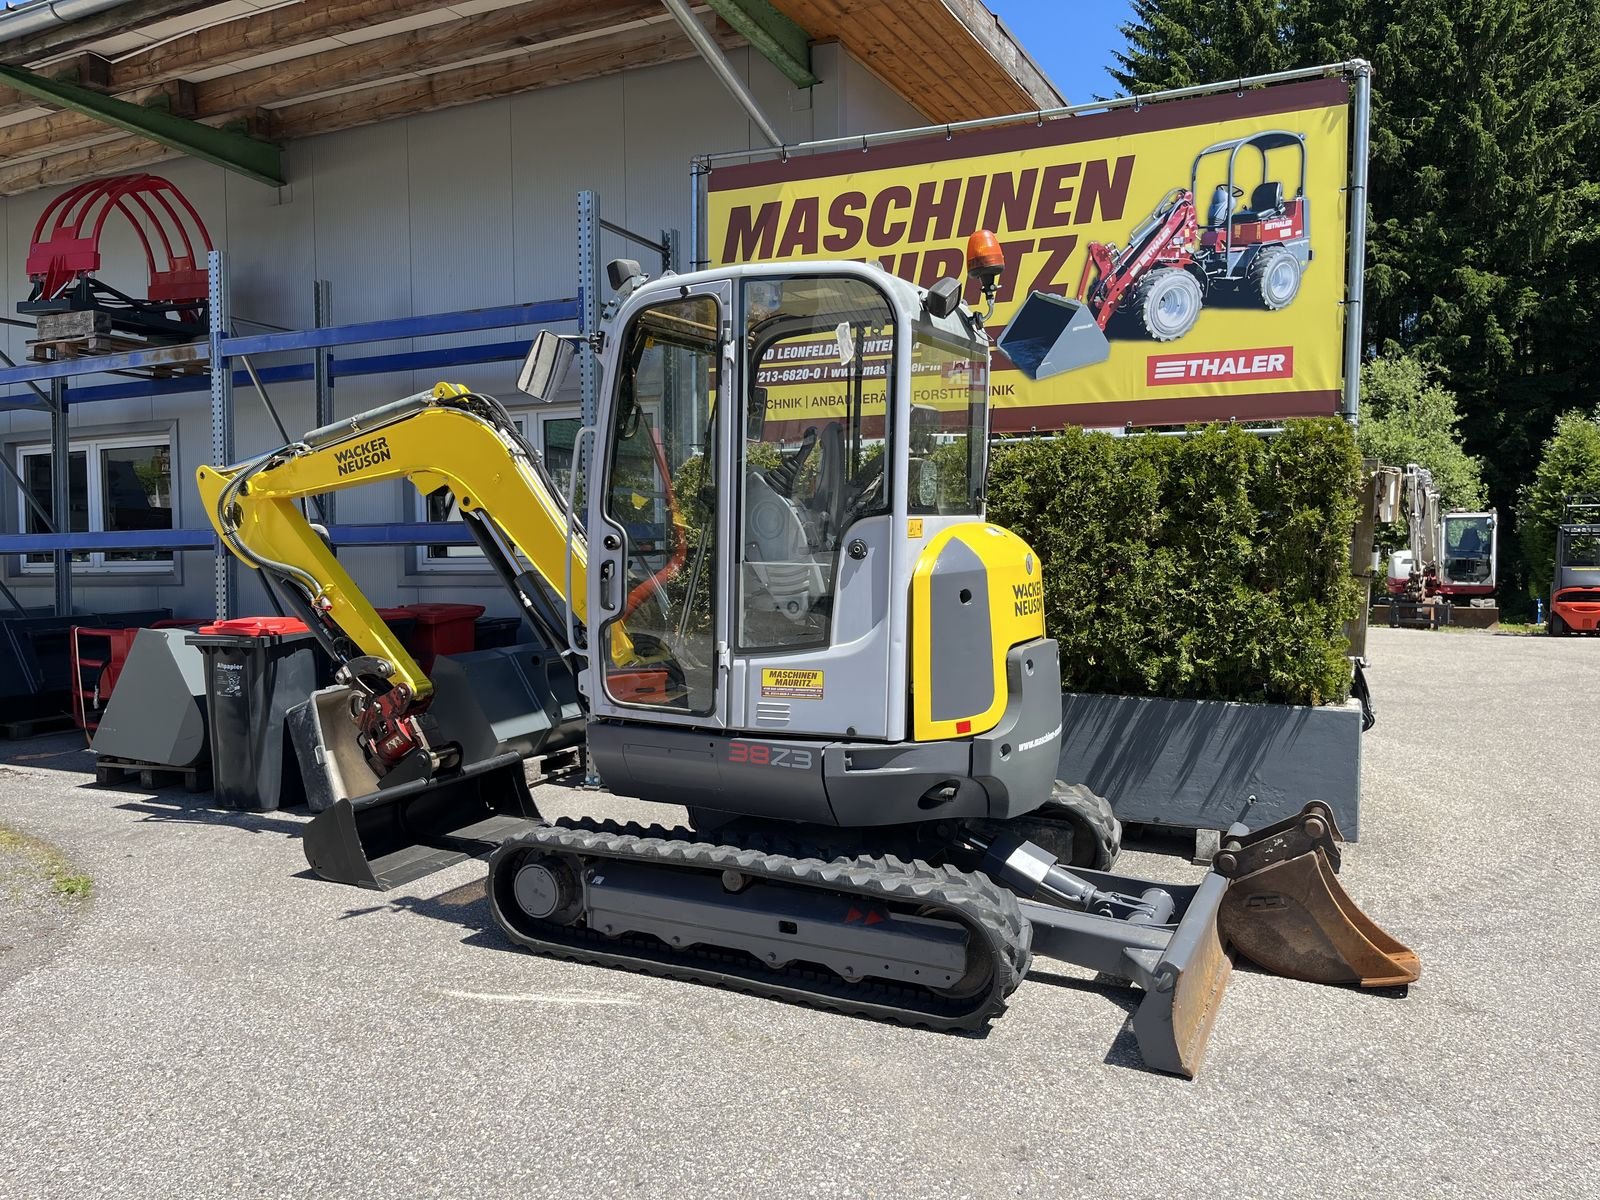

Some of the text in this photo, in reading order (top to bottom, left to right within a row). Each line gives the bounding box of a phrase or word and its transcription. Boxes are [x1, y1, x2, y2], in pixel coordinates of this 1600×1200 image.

[722, 155, 1137, 264] MASCHINEN
[777, 344, 841, 359] LEONFELDE
[1185, 354, 1286, 377] THALER
[334, 436, 389, 464] WACKER
[337, 447, 392, 477] NEUSON
[769, 670, 818, 680] MASCHINEN
[774, 678, 812, 687] MAURITZ
[728, 742, 812, 770] 38Z3
